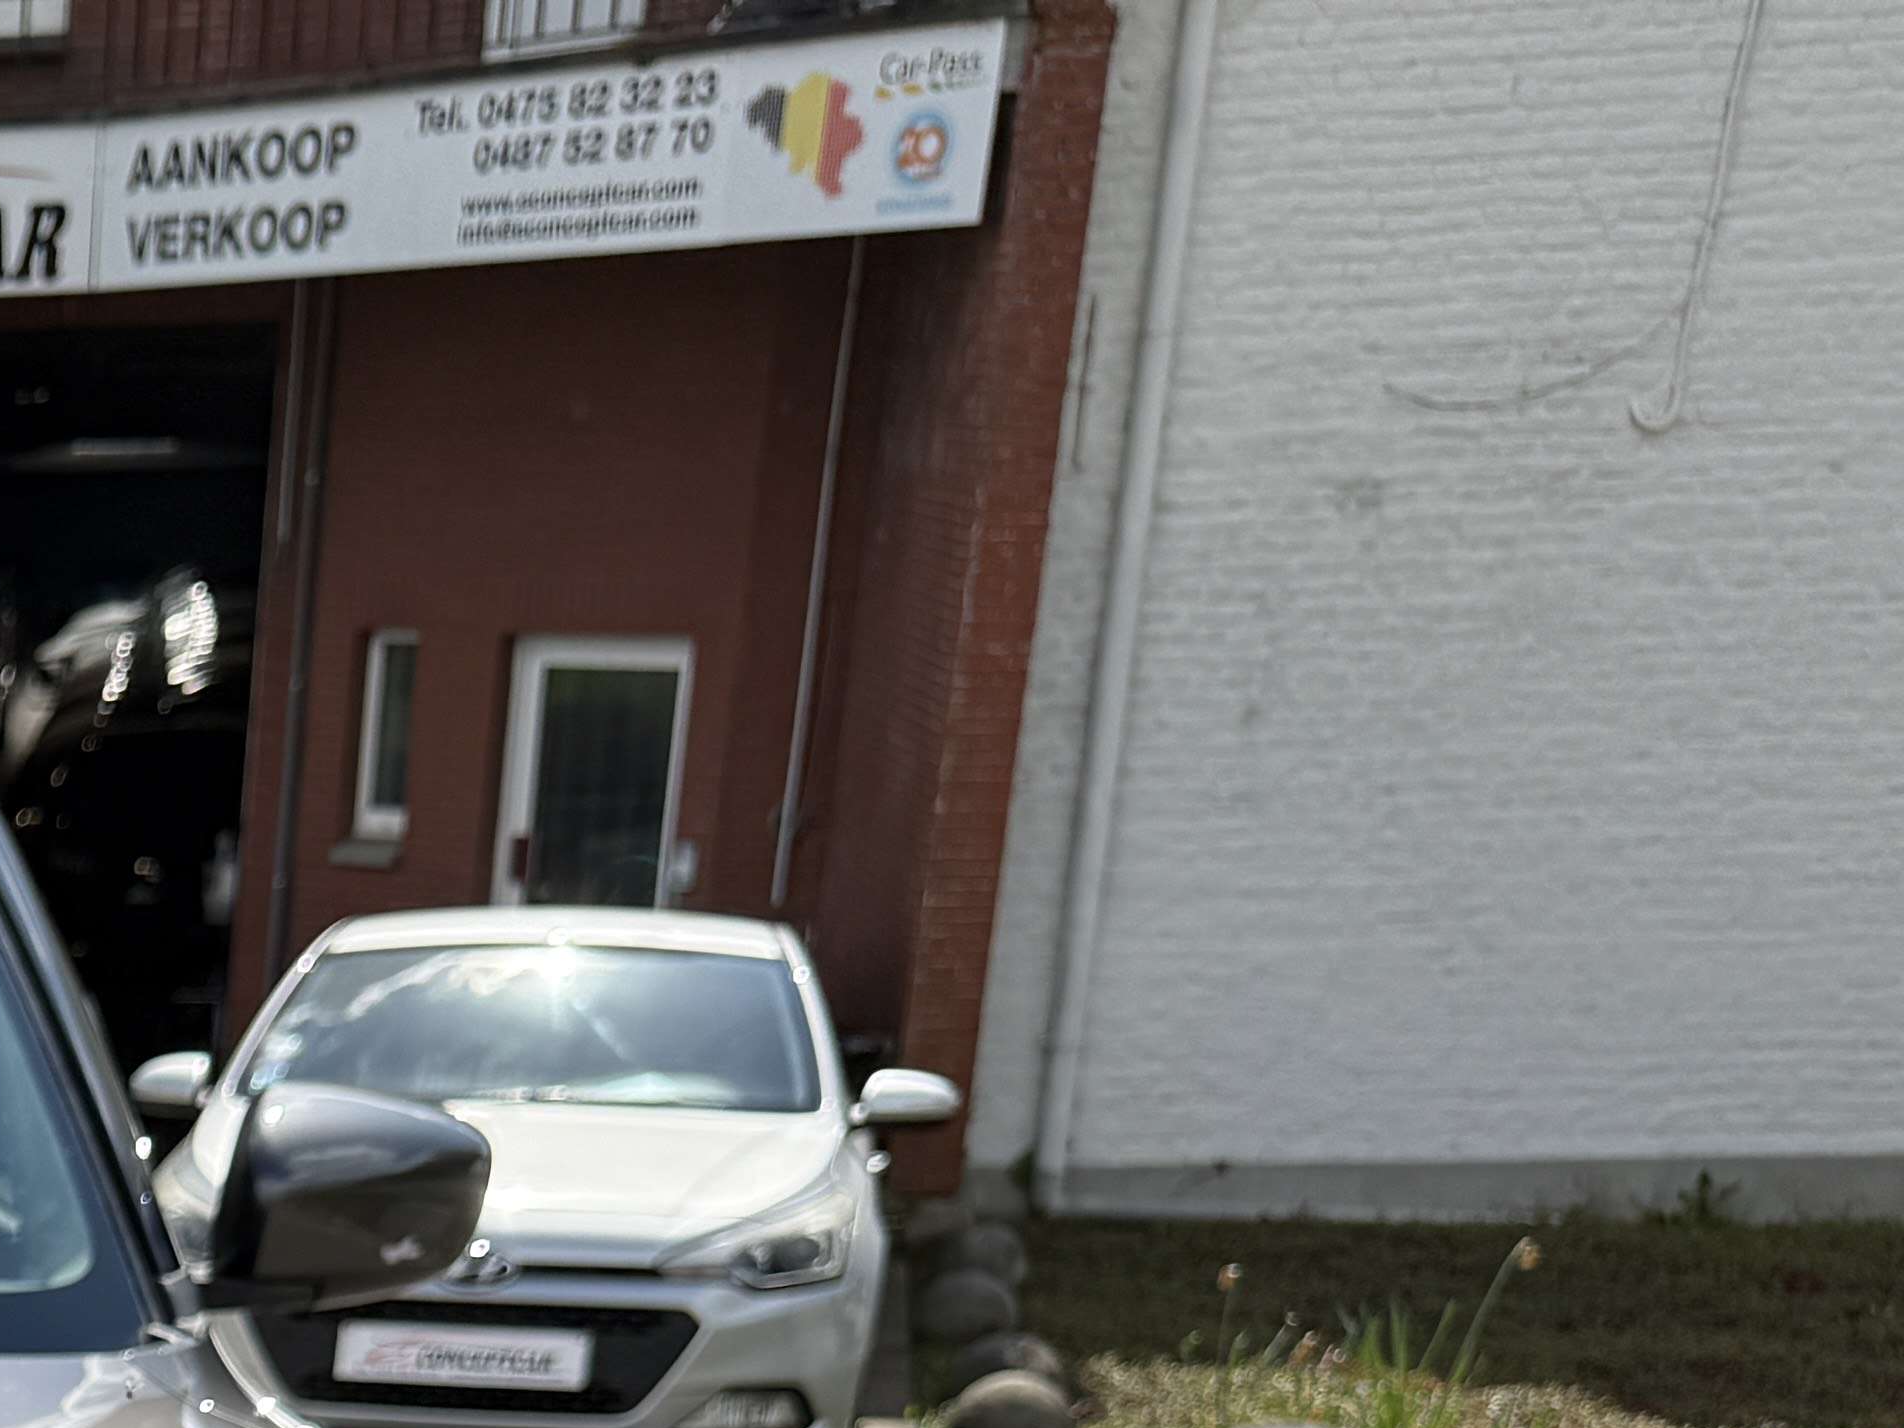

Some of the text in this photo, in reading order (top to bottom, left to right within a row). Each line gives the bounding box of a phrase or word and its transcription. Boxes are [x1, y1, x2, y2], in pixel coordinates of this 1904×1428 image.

[415, 67, 719, 136] Tel. 0475 82 32 23
[670, 114, 715, 156] 70
[127, 120, 357, 194] AANKOOP
[127, 198, 346, 266] VERKOOP
